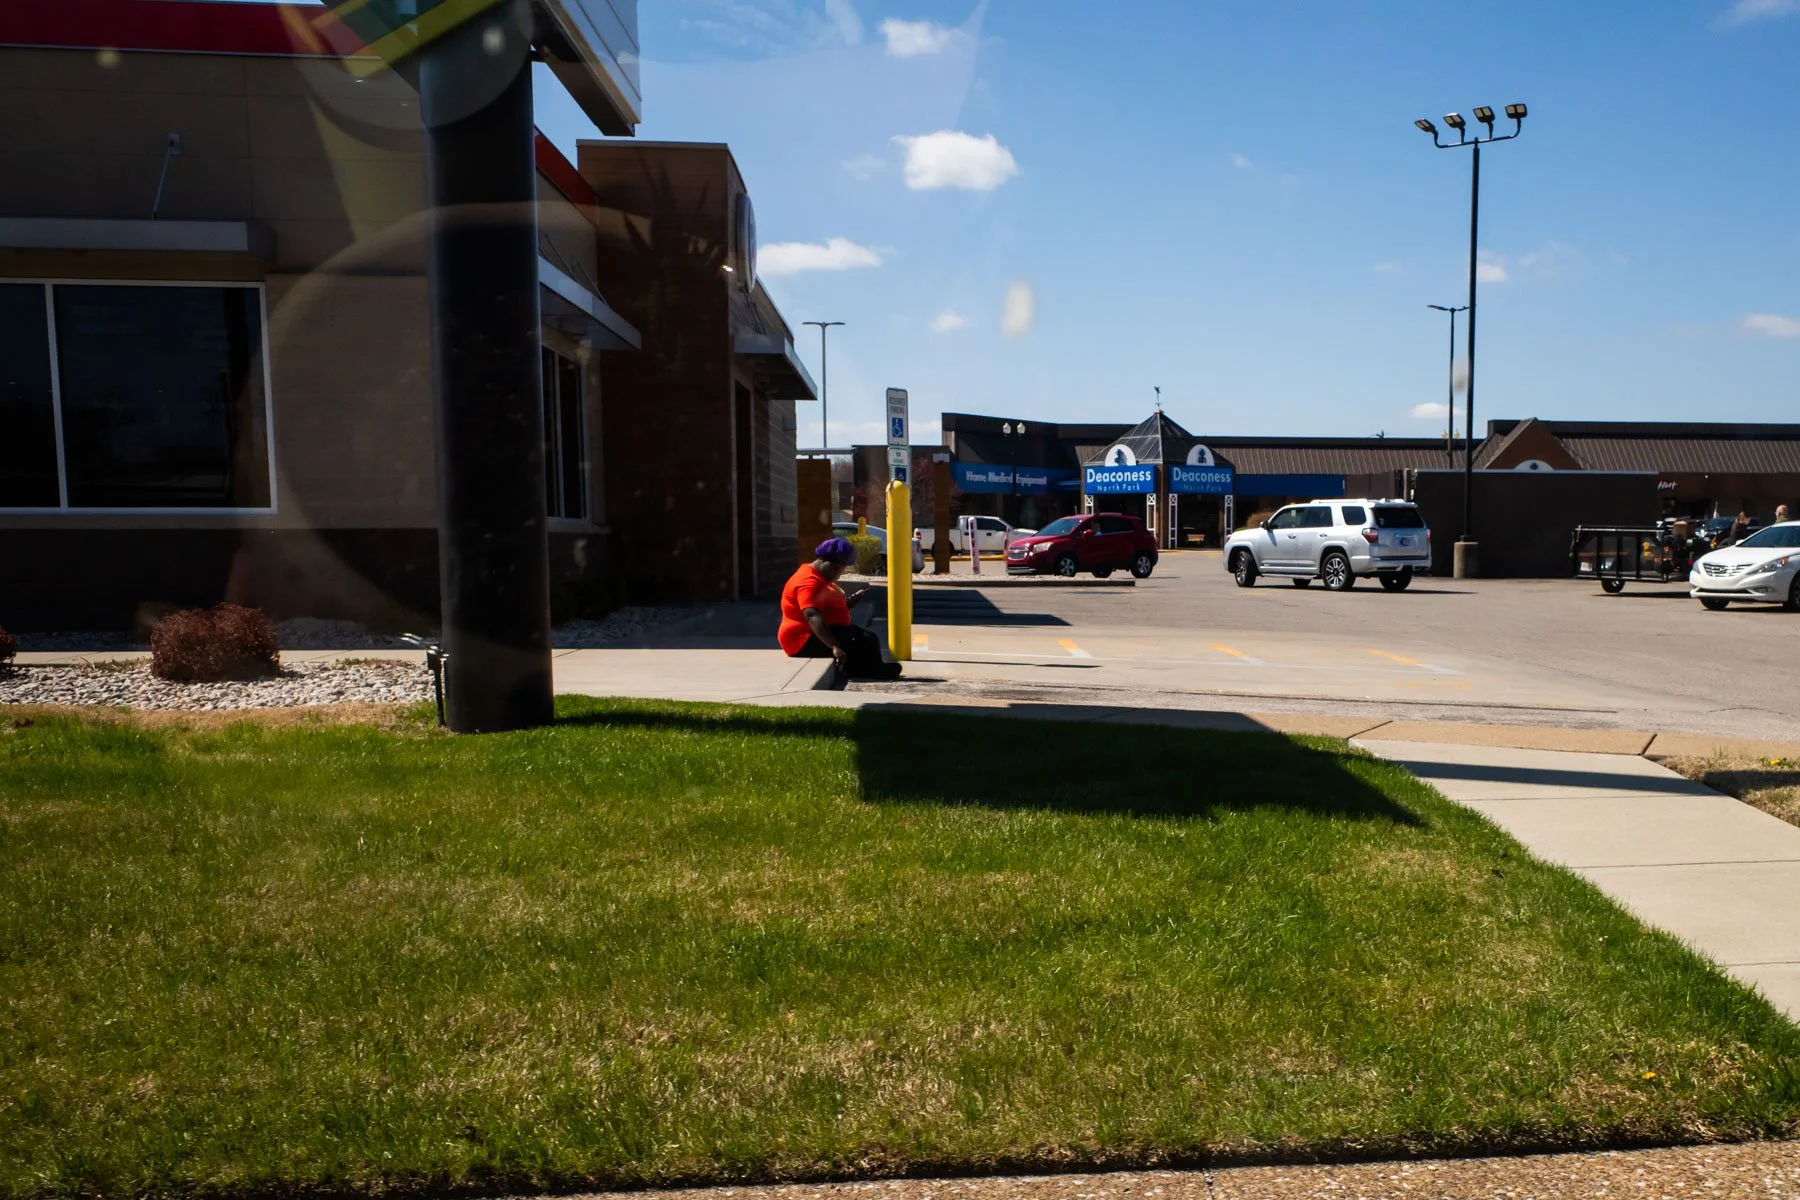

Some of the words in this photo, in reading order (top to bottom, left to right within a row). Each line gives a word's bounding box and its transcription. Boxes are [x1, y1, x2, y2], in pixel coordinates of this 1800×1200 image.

[966, 471, 986, 482] Home
[1086, 468, 1152, 483] Deaconess
[1173, 467, 1231, 483] Deaconess
[1097, 483, 1120, 491] North
[1122, 482, 1140, 491] Park
